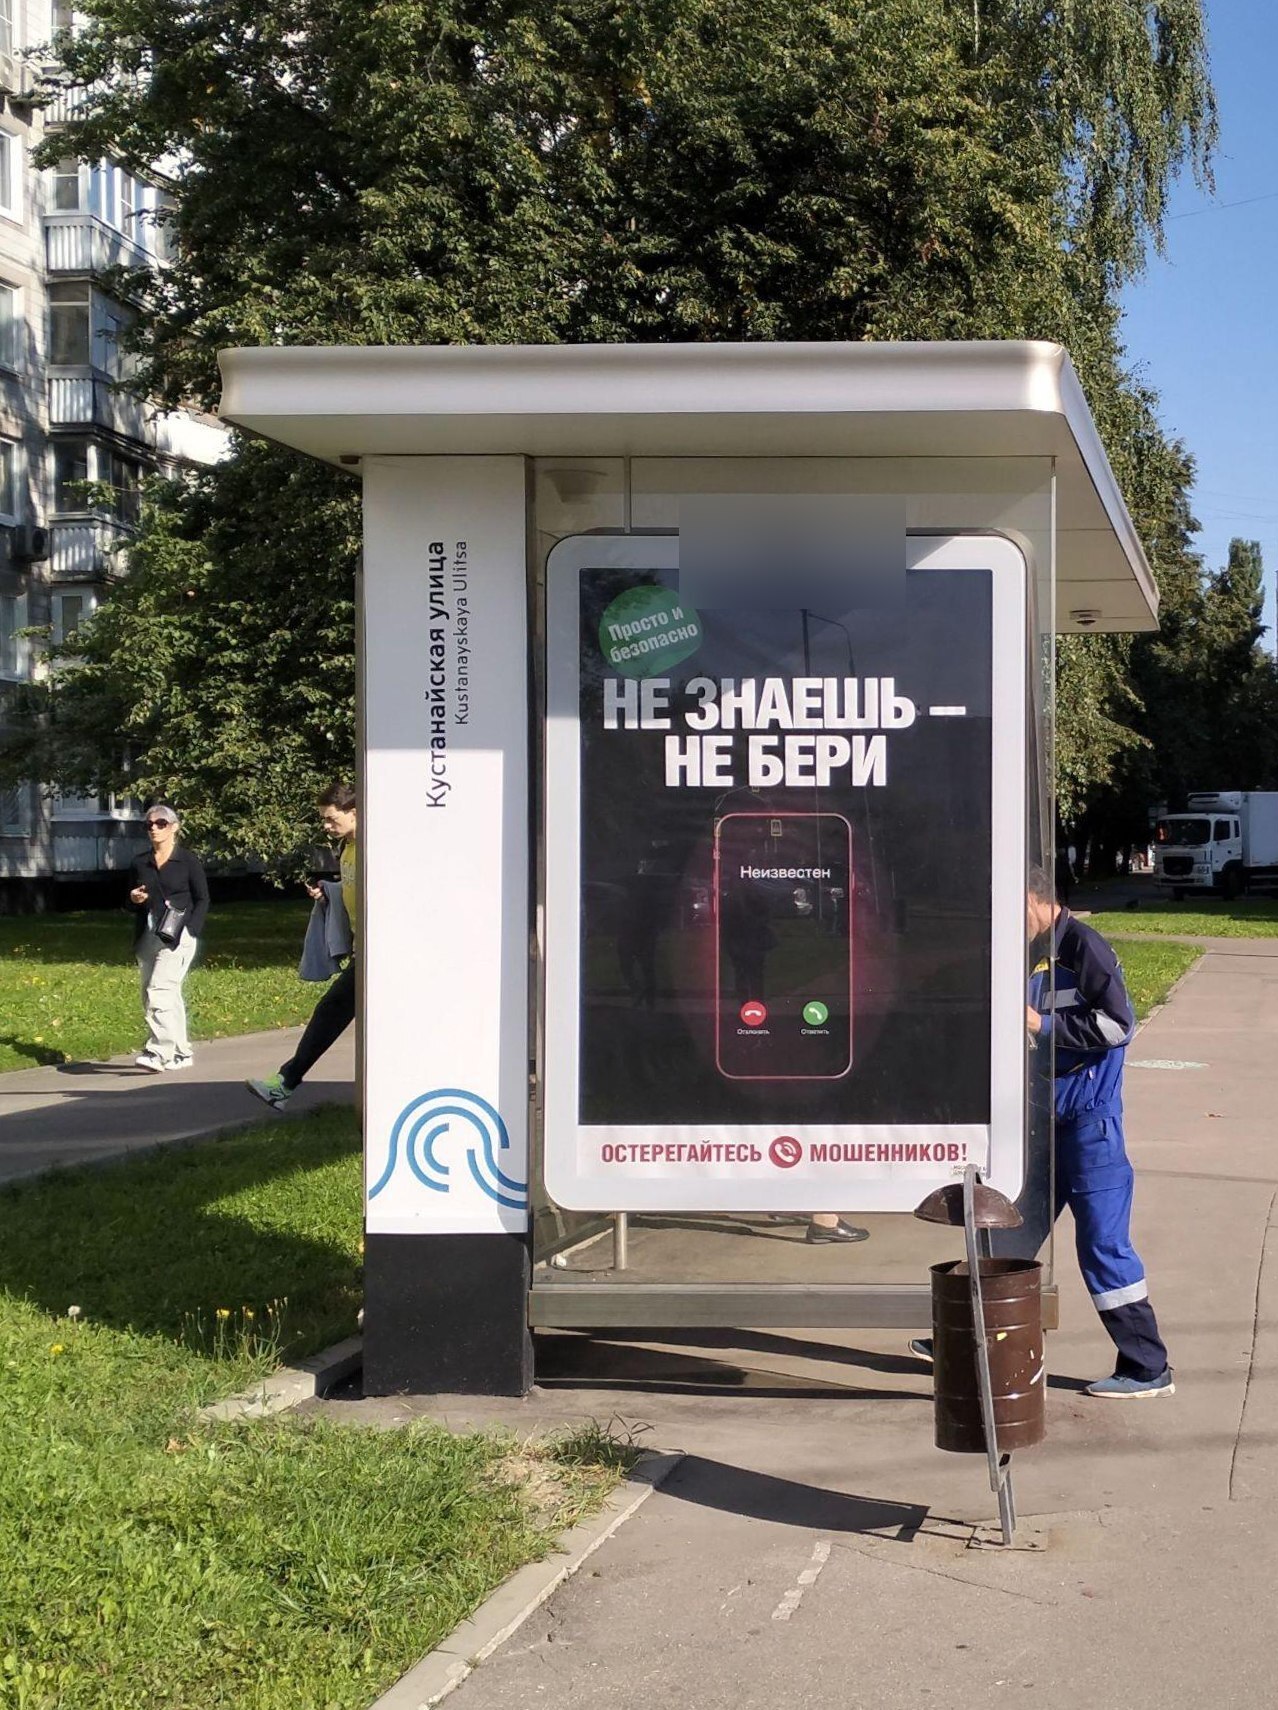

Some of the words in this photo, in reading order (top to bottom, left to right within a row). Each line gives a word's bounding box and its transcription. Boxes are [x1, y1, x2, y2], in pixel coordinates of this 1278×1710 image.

[428, 541, 450, 621] улица
[452, 541, 468, 593] Ulitsa
[608, 612, 669, 641] Просто
[671, 606, 684, 621] и
[610, 624, 698, 663] безопасно
[453, 597, 471, 726] Kustanayskaya
[425, 629, 451, 808] Кустанайская
[604, 678, 671, 729] НЕ
[685, 677, 916, 730] ЗНАЕШЬ
[665, 735, 733, 786] НЕ
[749, 735, 887, 786] БЕРИ
[740, 865, 831, 879] Неизвестен
[601, 1140, 762, 1163] ОСТЕРЕГАЙТЕСЬ
[810, 1142, 967, 1162] МОШЕННИКОВ!
